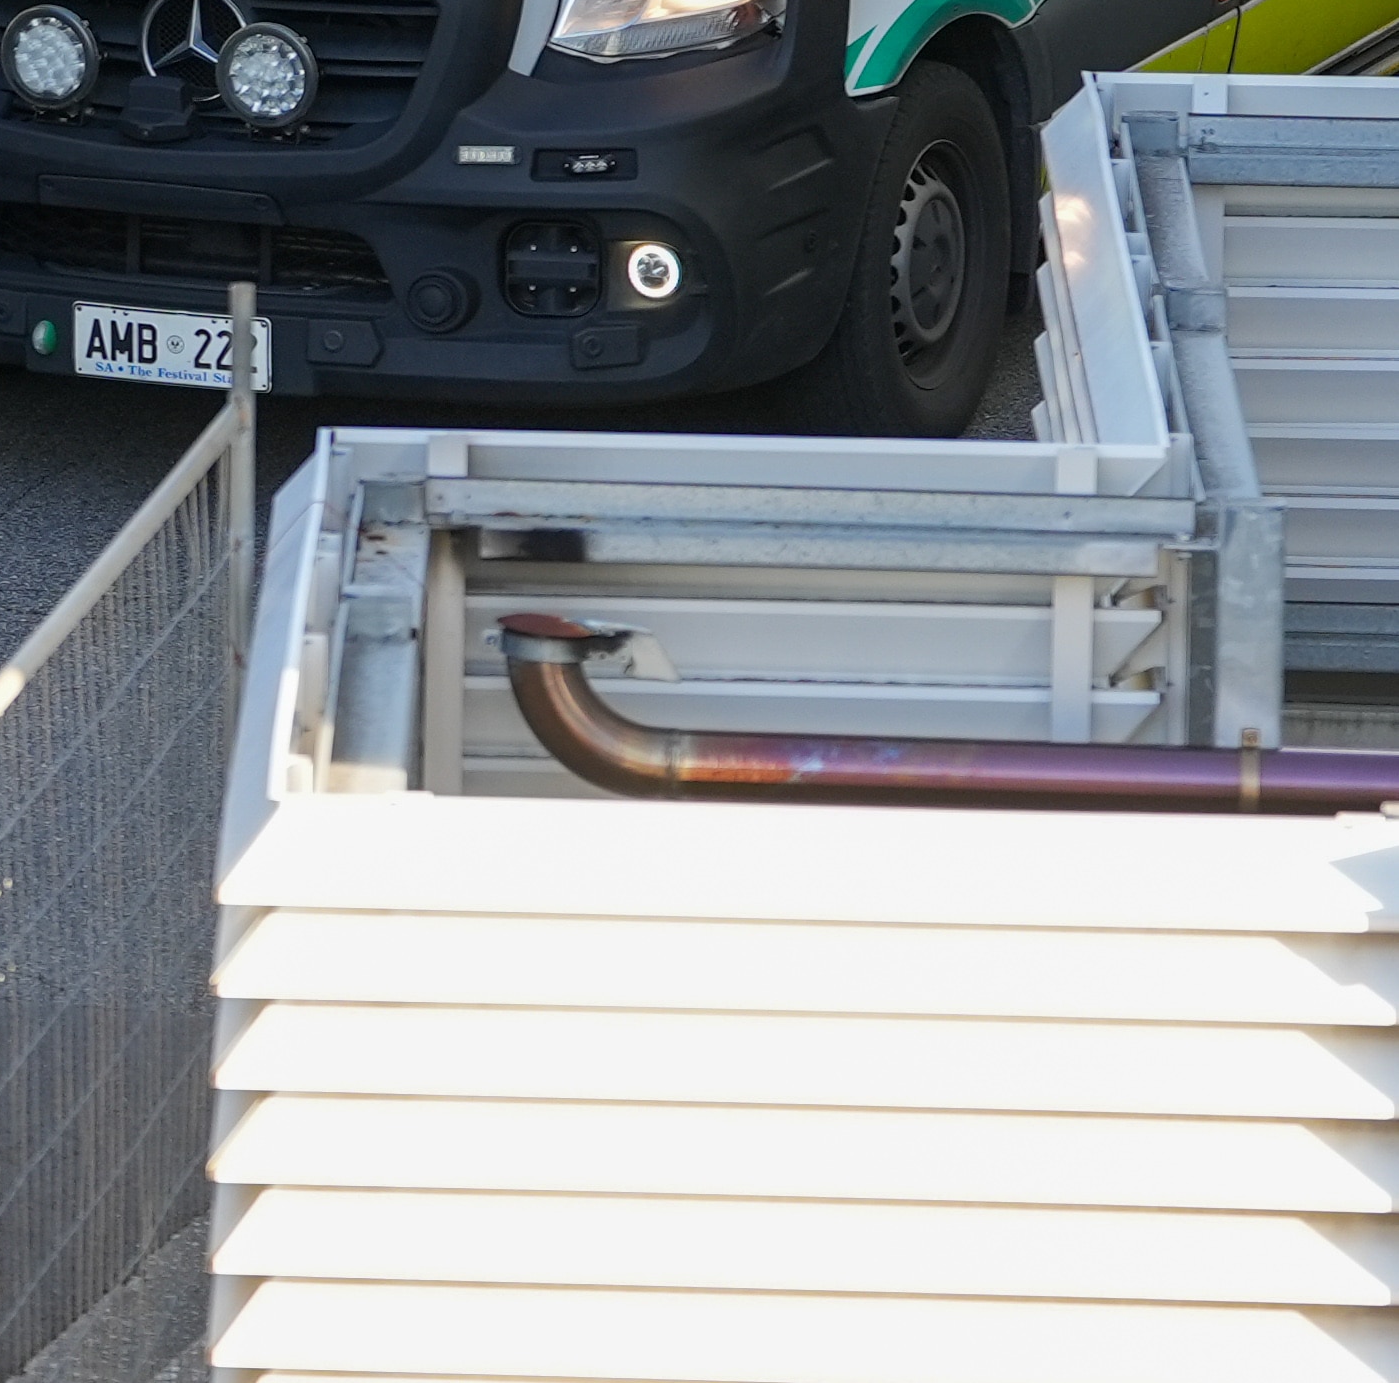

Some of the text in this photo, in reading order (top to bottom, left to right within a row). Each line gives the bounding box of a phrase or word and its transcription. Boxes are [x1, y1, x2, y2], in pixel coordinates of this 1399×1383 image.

[85, 318, 258, 374] AMB 22
[95, 361, 233, 385] SA The Festival Sta
